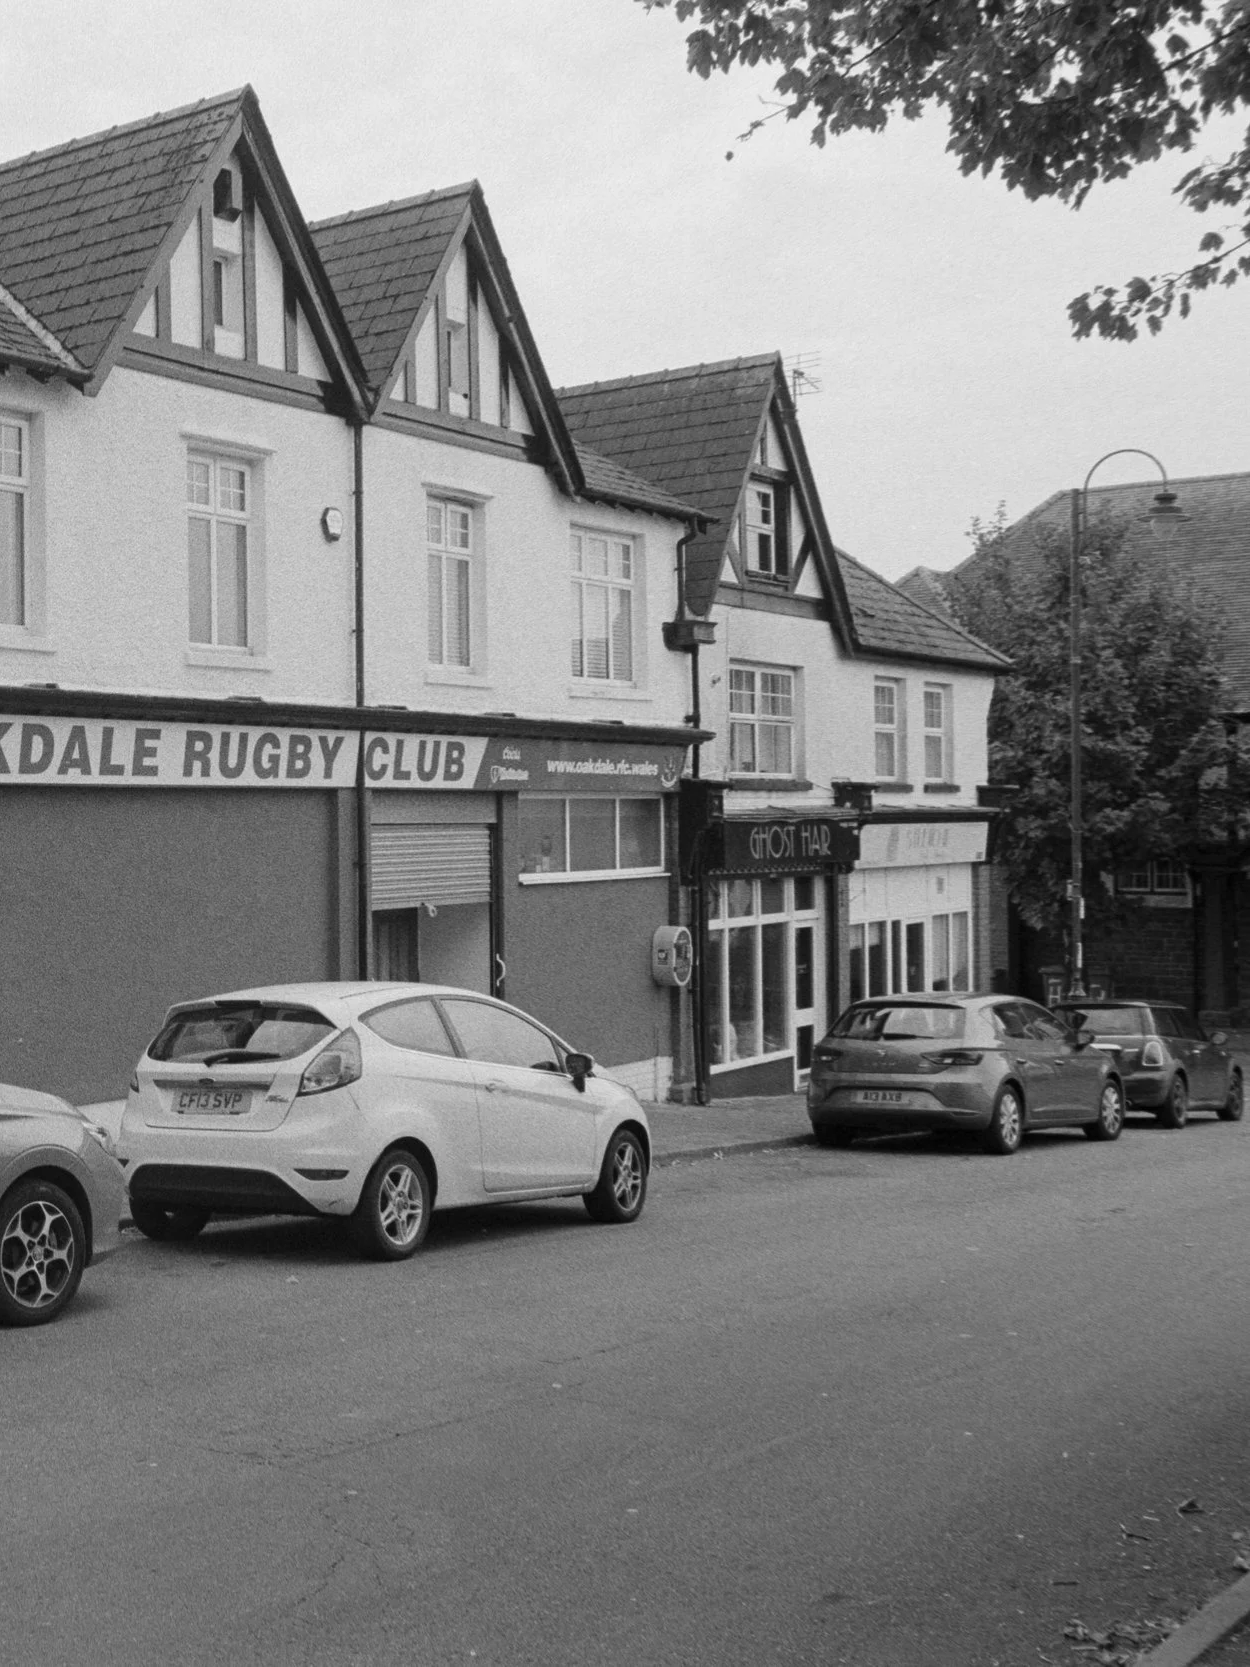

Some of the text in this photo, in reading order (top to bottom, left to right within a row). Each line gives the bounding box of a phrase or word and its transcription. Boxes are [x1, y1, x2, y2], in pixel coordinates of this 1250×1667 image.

[182, 729, 347, 781] RUGBY
[364, 735, 466, 784] CLUB
[547, 758, 659, 776] www.oakdale.rfc.wales
[750, 825, 796, 859] GHOST
[179, 1091, 243, 1109] CF13 SVP
